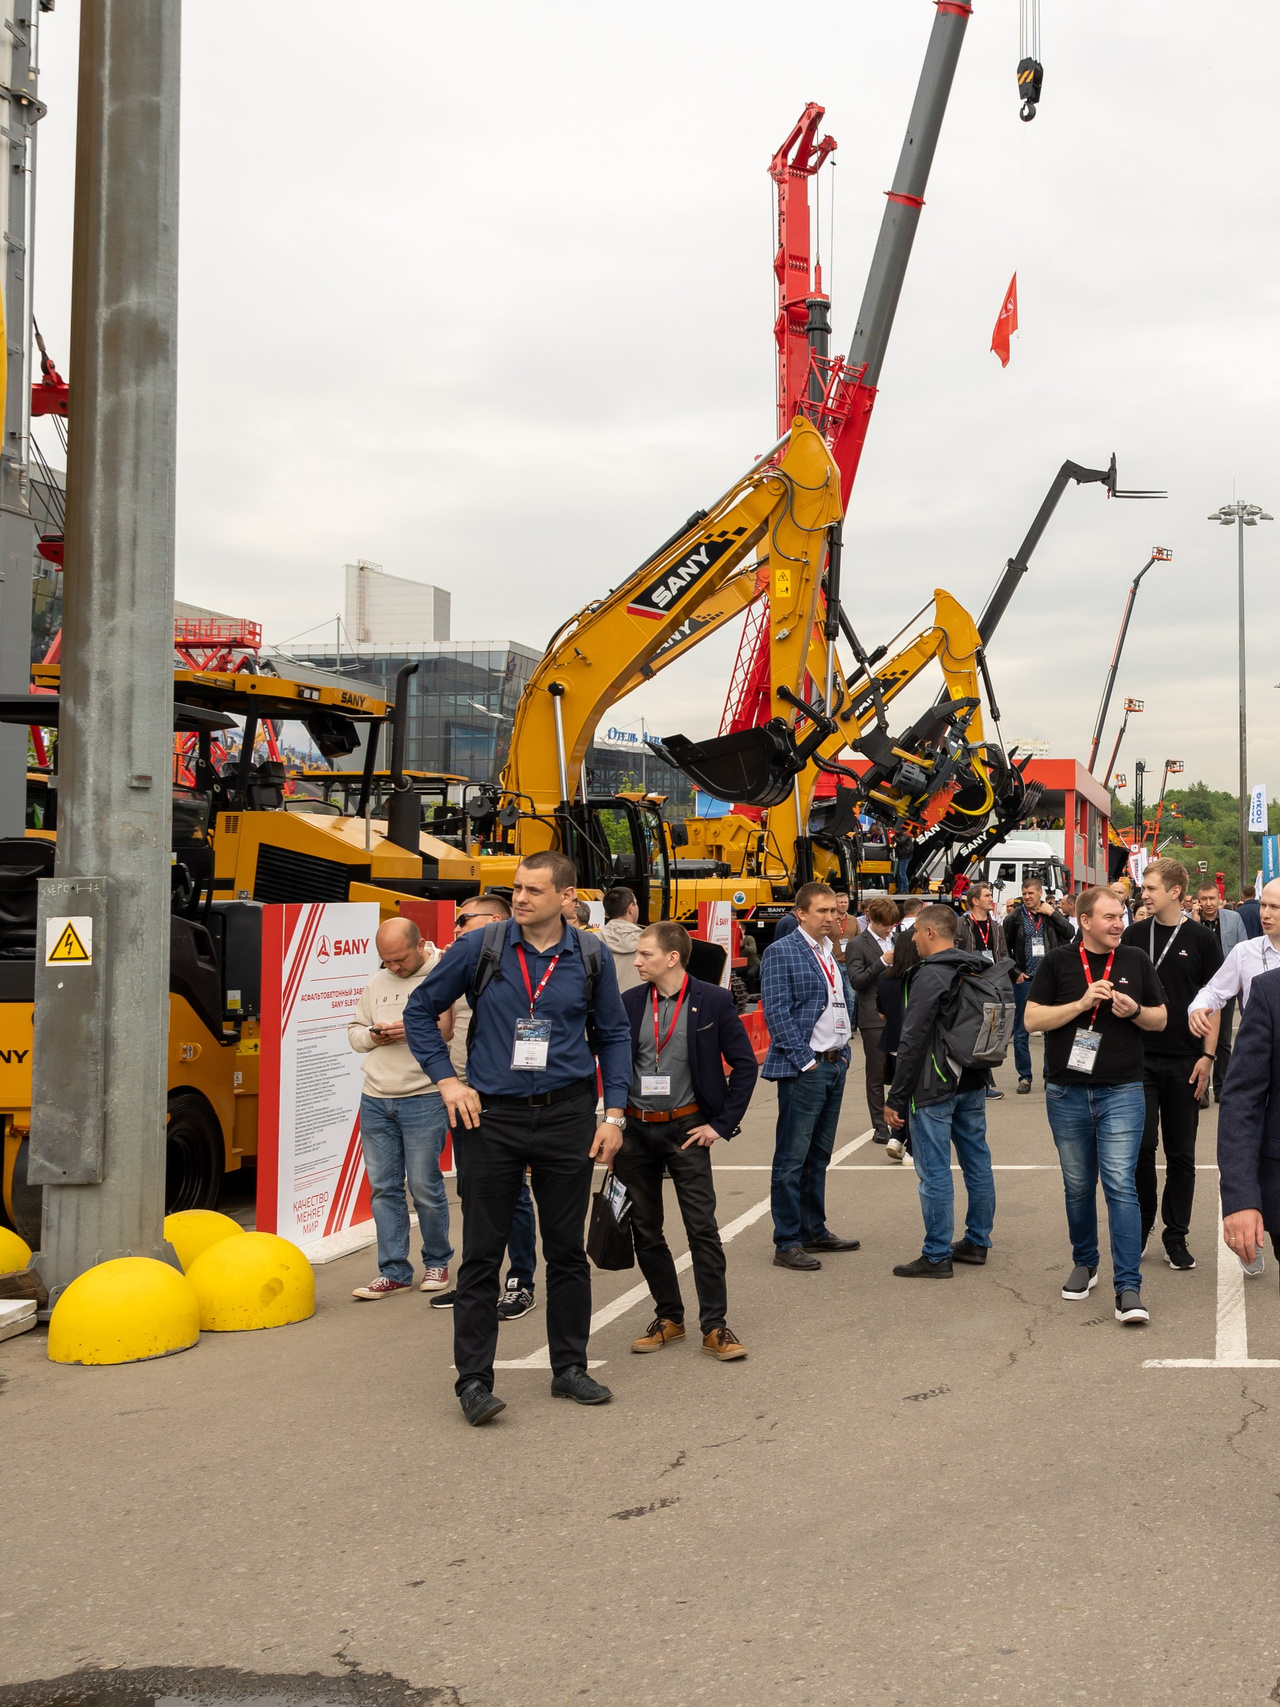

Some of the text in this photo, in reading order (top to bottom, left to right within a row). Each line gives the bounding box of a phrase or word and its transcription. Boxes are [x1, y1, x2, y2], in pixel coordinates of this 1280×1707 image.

[651, 545, 710, 608] SANY
[341, 691, 366, 708] SANY
[915, 823, 941, 845] SAN
[959, 831, 988, 857] SANY
[333, 938, 370, 956] SANY
[331, 1001, 344, 1009] SANY
[292, 1191, 329, 1213] КАЧЕСТВО
[296, 1205, 325, 1225] МЕНЯЕТ
[302, 1221, 319, 1236] МИР
